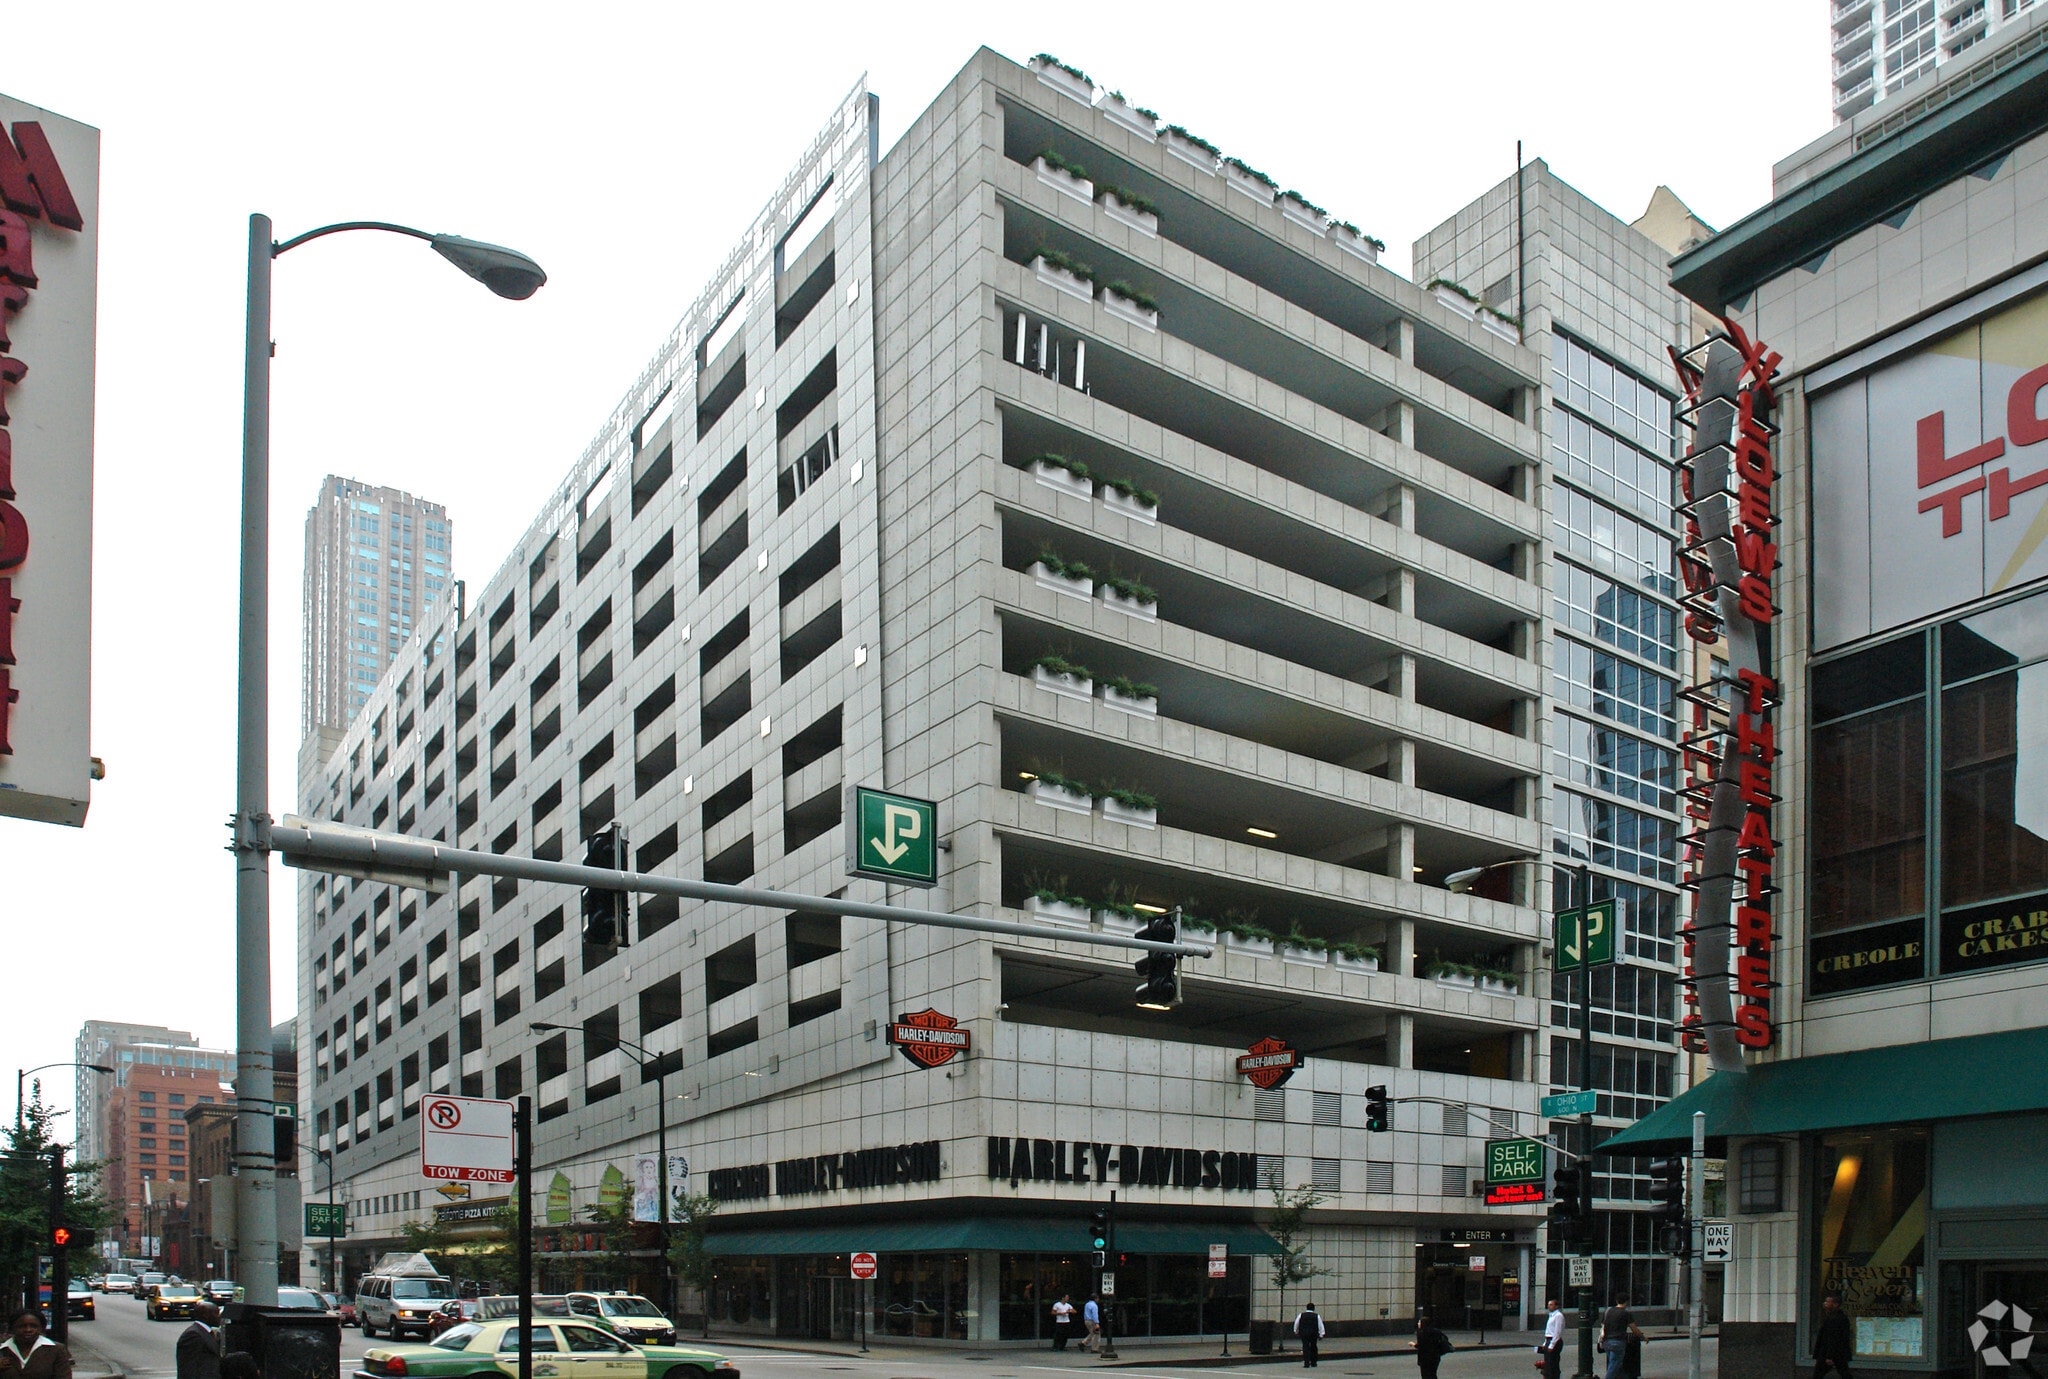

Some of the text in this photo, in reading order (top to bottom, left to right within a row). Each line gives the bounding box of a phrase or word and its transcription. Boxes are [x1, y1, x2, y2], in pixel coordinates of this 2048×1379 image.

[1733, 390, 1777, 624] LOEWS
[1735, 667, 1775, 1051] THEATRES
[1964, 910, 2048, 939] CRAB
[1817, 941, 1920, 974] CREOLE
[914, 1013, 951, 1029] MOTOR
[898, 1027, 966, 1046] HARLEY-DAVIDSON
[915, 1045, 949, 1062] CYCLES
[1241, 1052, 1292, 1070] HARLEY-DAVIDSON
[1557, 1095, 1577, 1107] OHIO
[1494, 1144, 1536, 1163] SELF
[987, 1136, 1257, 1190] HARLEY-DAVIDSON
[1493, 1160, 1537, 1177] PARK
[428, 1166, 508, 1182] TOW ZONE
[311, 1207, 339, 1216] SELF
[465, 1208, 482, 1219] PIZZA
[311, 1216, 340, 1225] PARK
[1465, 1230, 1491, 1240] ENTER
[1708, 1226, 1729, 1237] ONE
[1706, 1236, 1730, 1247] WAY
[1830, 1262, 1911, 1279] Heaven
